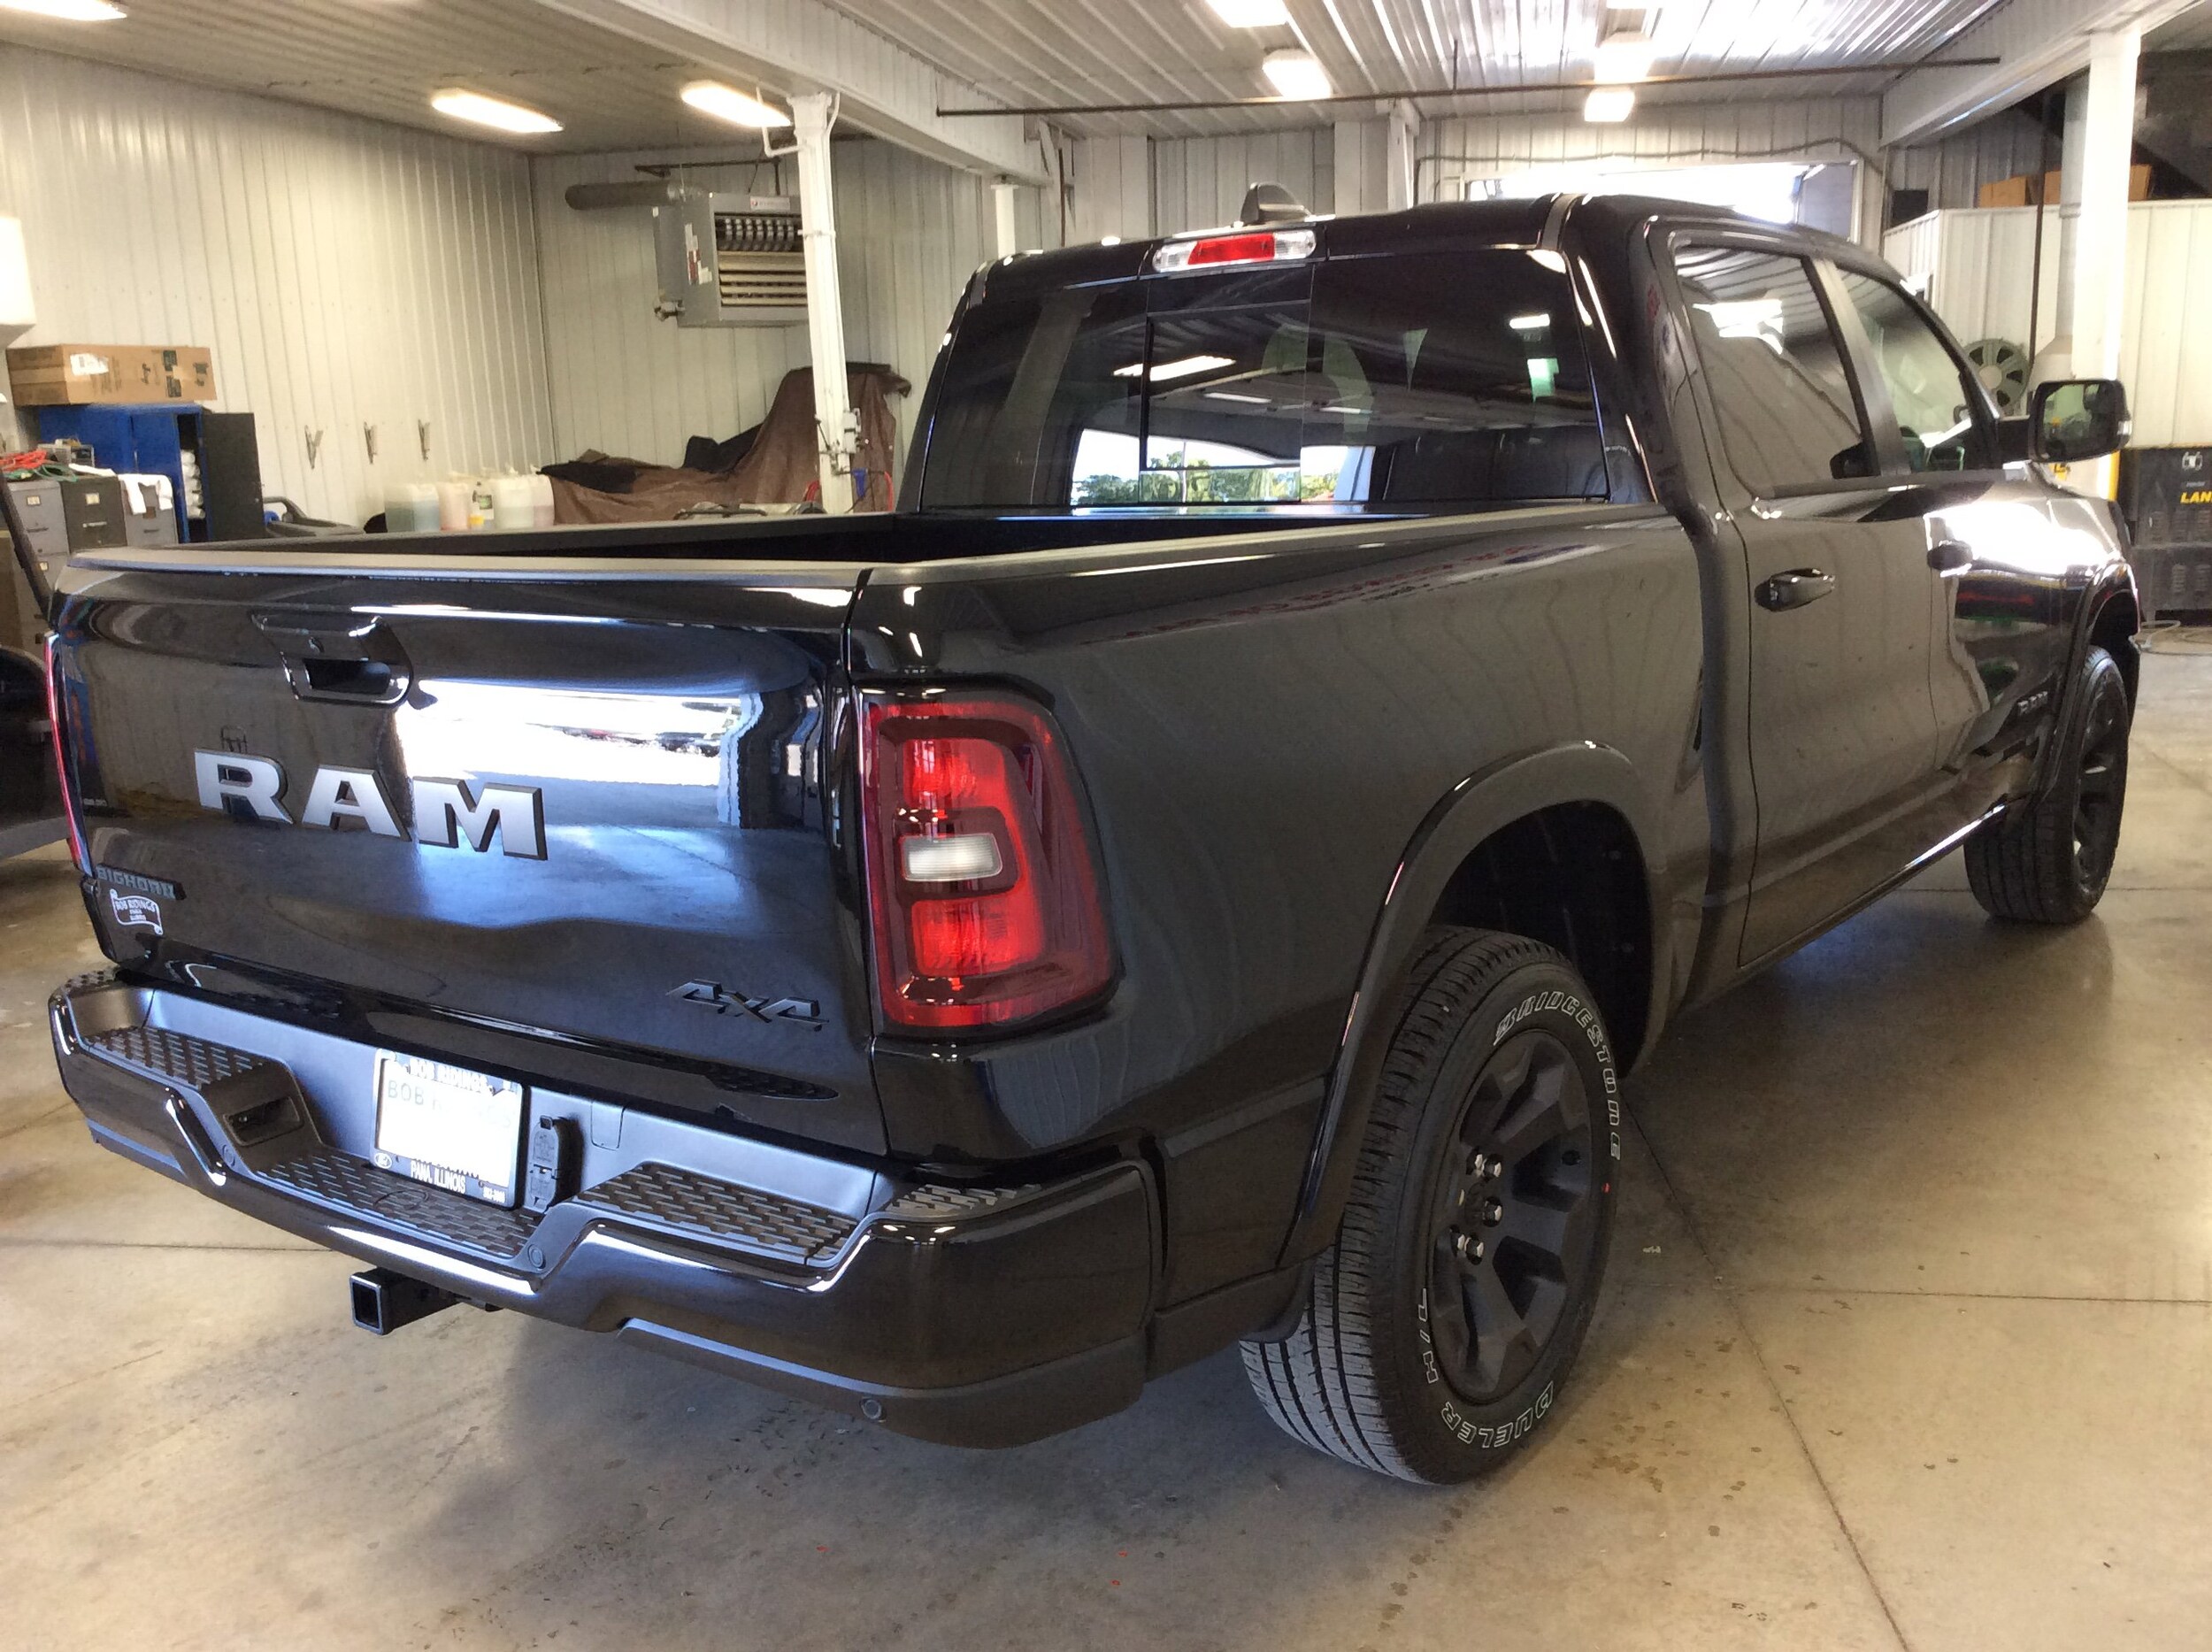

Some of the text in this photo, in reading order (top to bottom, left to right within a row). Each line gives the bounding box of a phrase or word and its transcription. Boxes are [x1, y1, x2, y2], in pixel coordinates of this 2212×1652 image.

[2180, 491, 2212, 504] LAN
[194, 748, 548, 861] RAM
[388, 1080, 424, 1106] BOB
[1493, 990, 1621, 1161] BRIDGESTONE
[434, 1167, 466, 1195] ILLINOIS
[1440, 1380, 1554, 1448] DUELER
